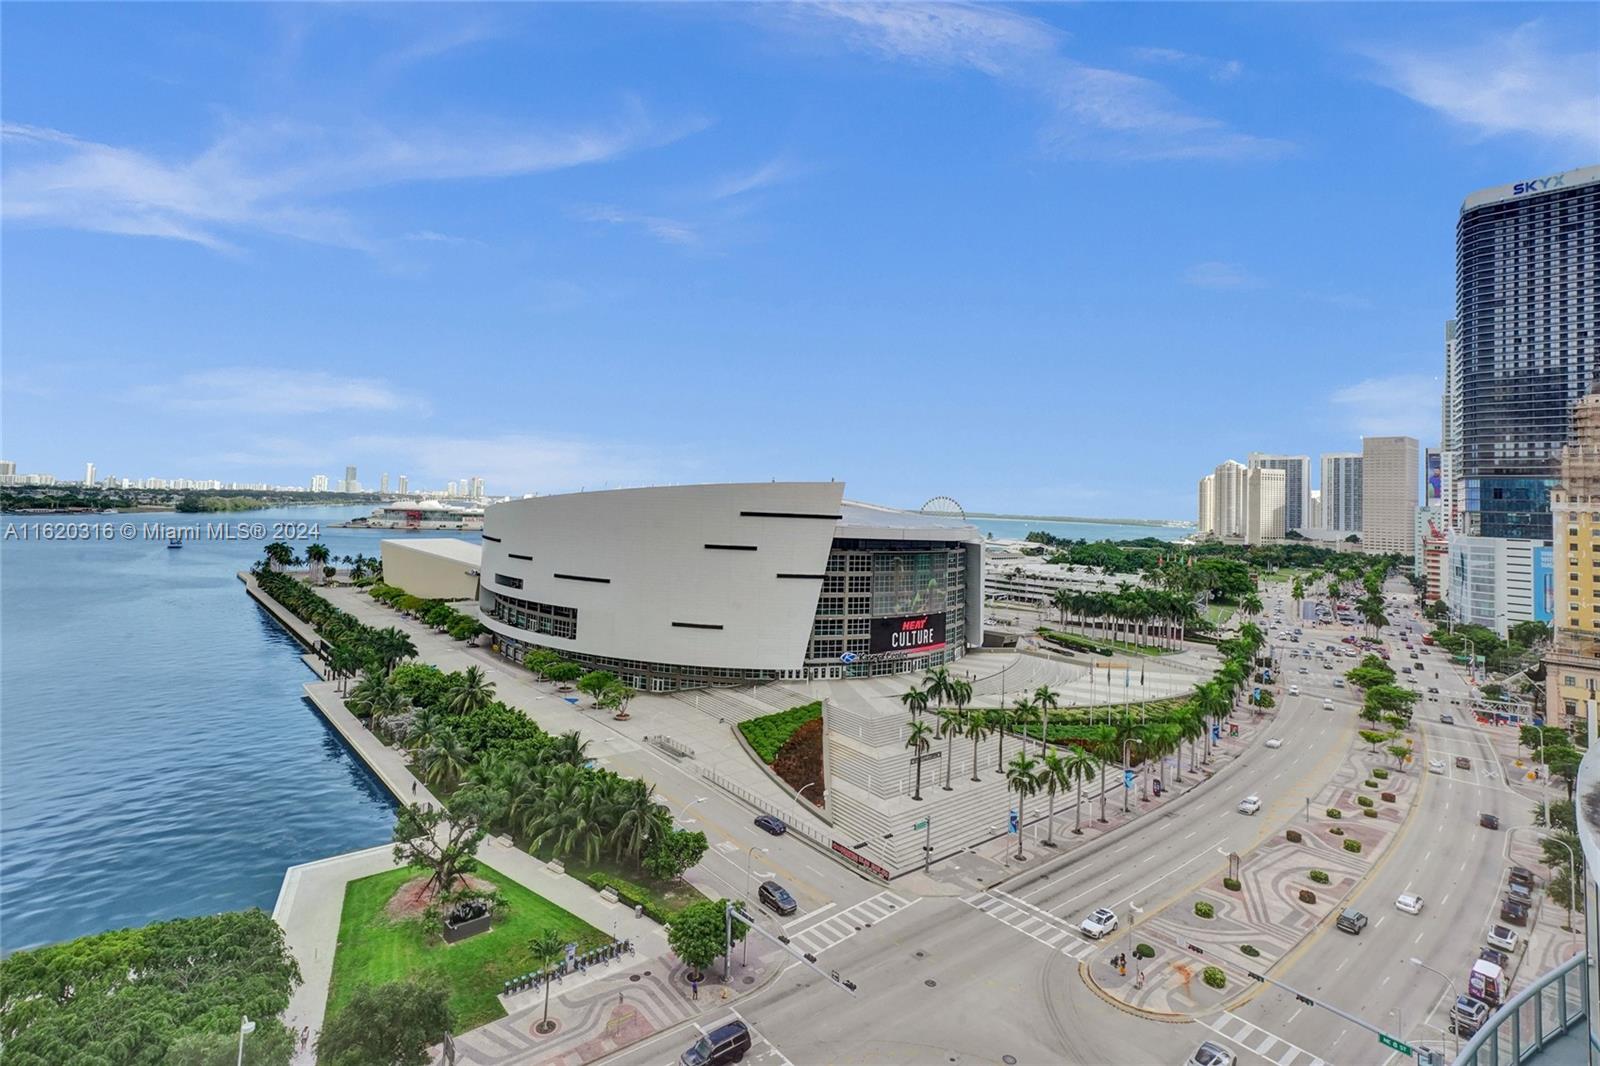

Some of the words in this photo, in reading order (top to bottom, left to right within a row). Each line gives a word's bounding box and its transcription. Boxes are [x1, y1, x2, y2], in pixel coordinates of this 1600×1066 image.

[1513, 175, 1565, 195] SKYX
[902, 616, 928, 630] HEAT
[892, 628, 934, 647] CULTURE
